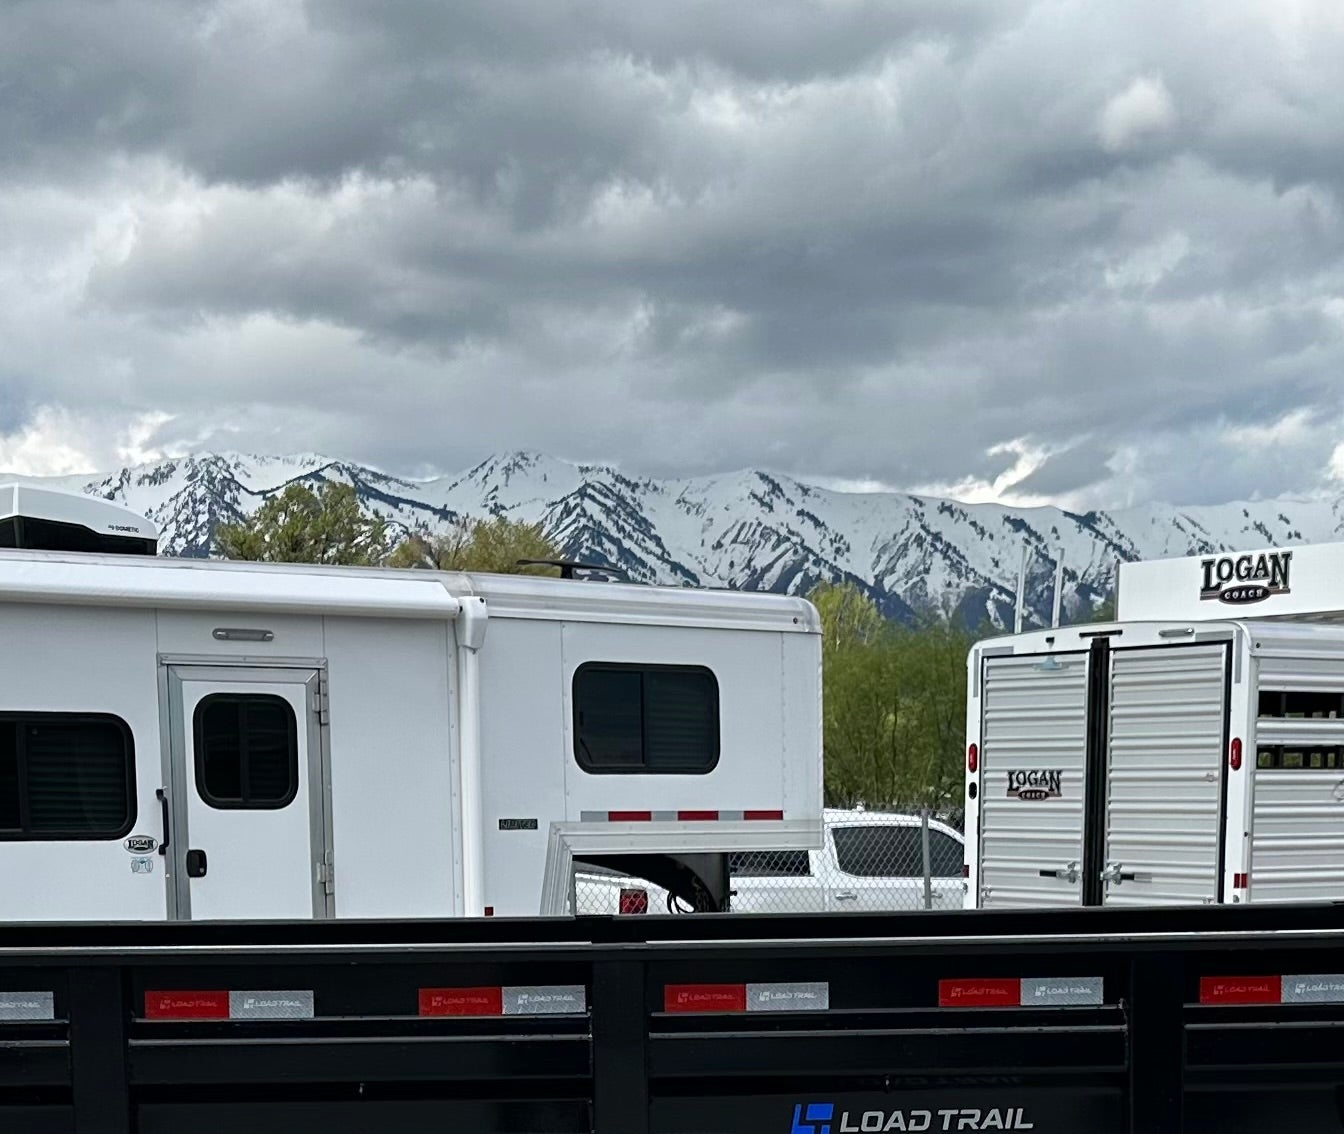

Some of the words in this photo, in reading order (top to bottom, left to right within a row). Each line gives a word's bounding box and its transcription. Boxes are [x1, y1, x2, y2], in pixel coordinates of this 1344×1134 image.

[1200, 551, 1293, 592] LOGAN
[1224, 589, 1264, 599] COACH
[1007, 770, 1063, 793] LOGAN
[839, 1110, 932, 1133] LOAD
[937, 1108, 1034, 1131] TRAIL
